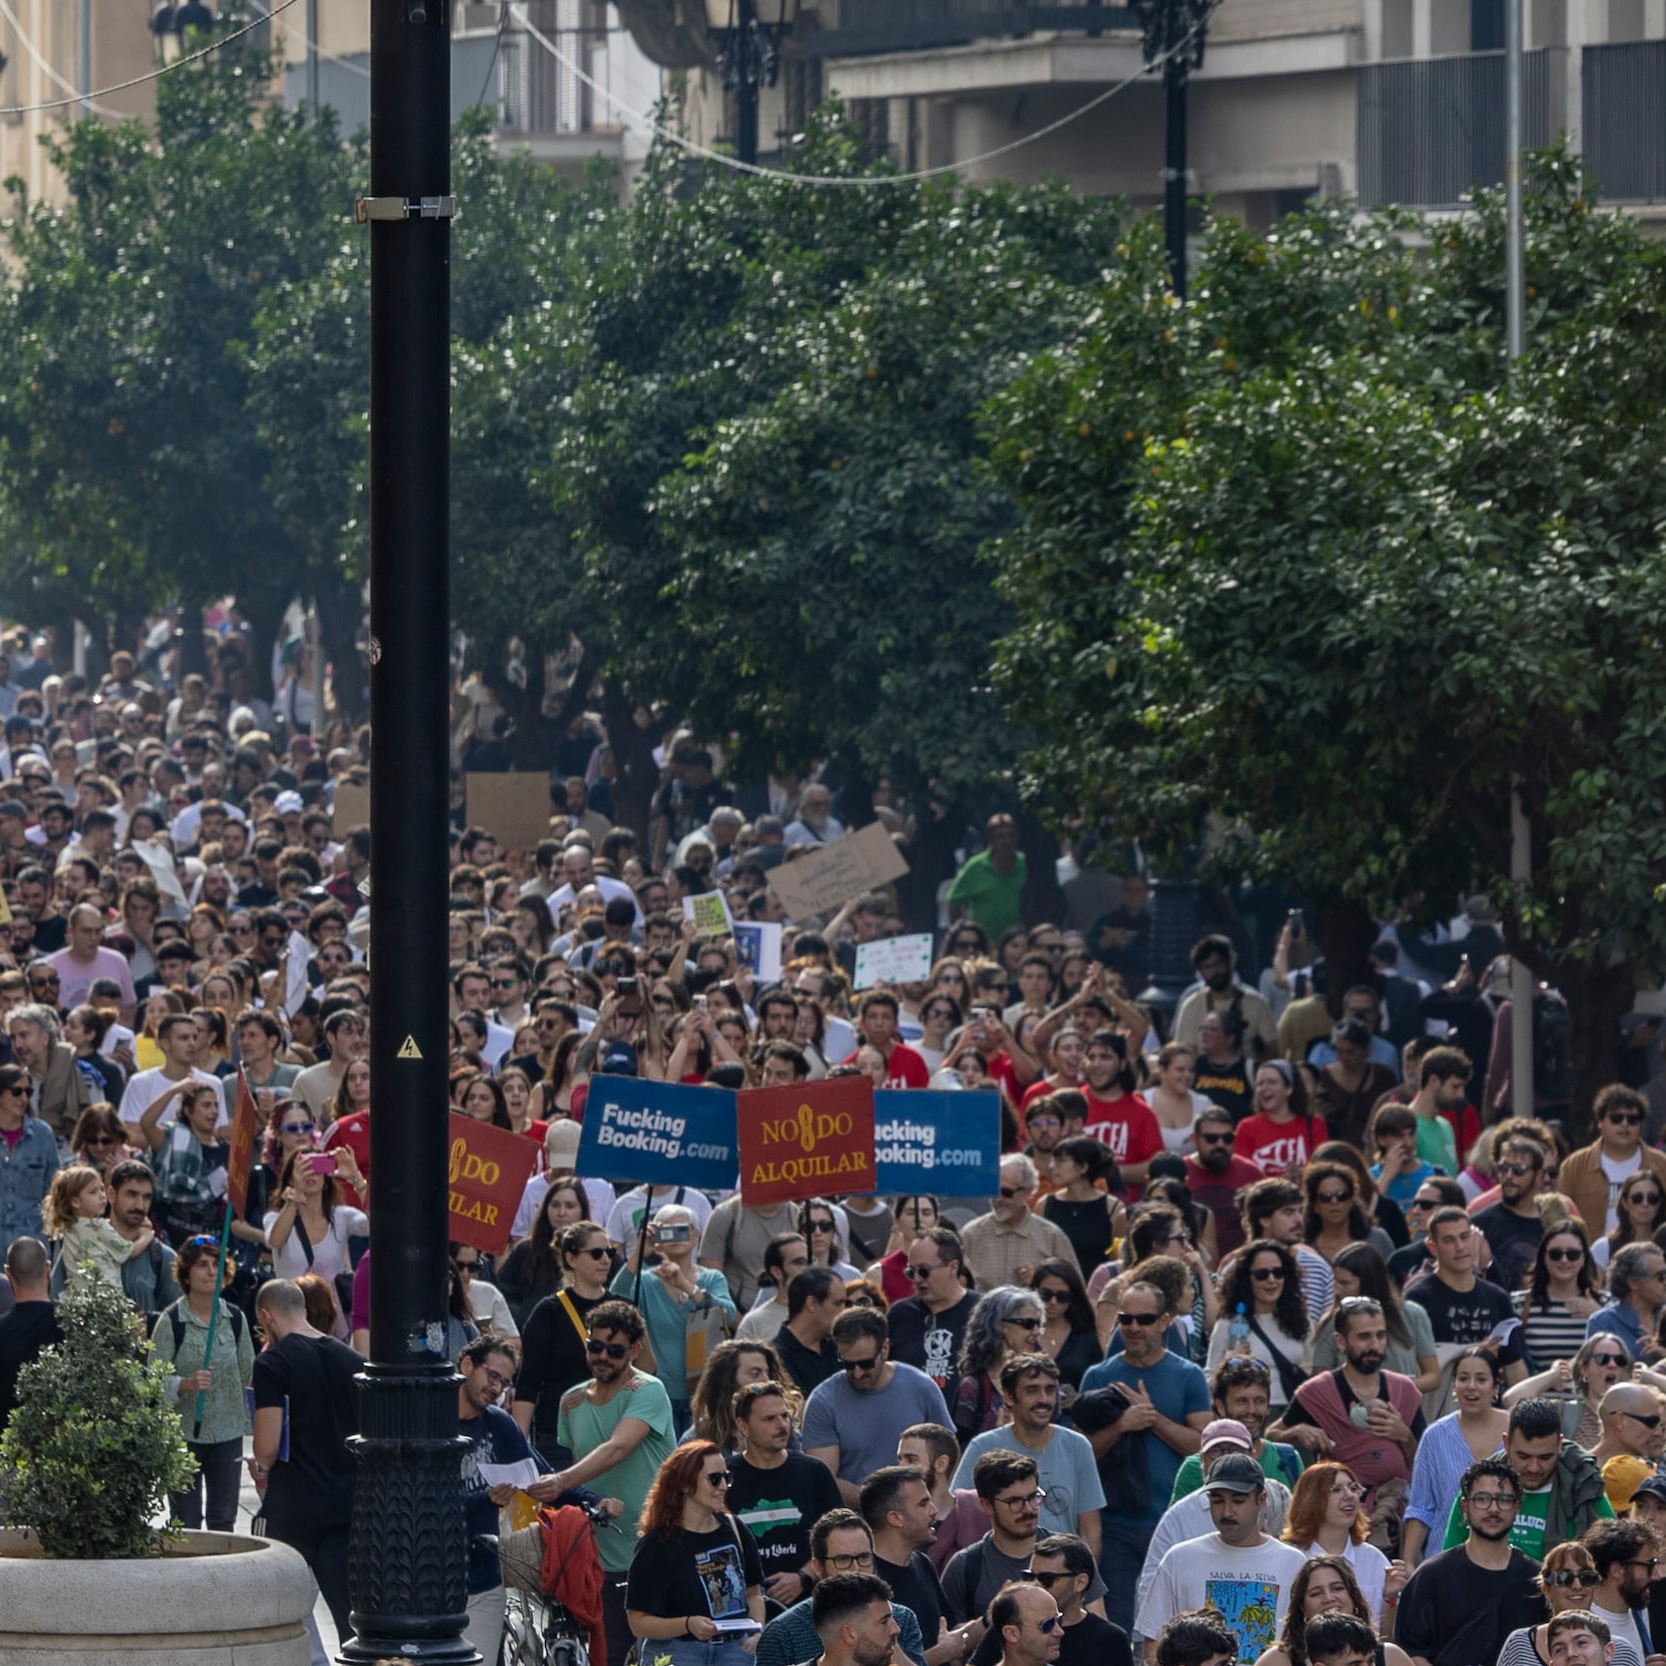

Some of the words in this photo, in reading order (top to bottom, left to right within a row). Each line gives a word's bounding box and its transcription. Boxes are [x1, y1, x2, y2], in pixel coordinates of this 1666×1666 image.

[602, 1104, 686, 1138] Fucking
[874, 1121, 936, 1146] ucking
[597, 1126, 729, 1162] Booking.com
[874, 1145, 982, 1170] ooking.com
[751, 1151, 868, 1185] ALQUILAR
[448, 1190, 498, 1227] ILAR
[1209, 1571, 1235, 1580] SALVA
[1239, 1571, 1251, 1580] LA
[1255, 1572, 1278, 1583] SELVA
